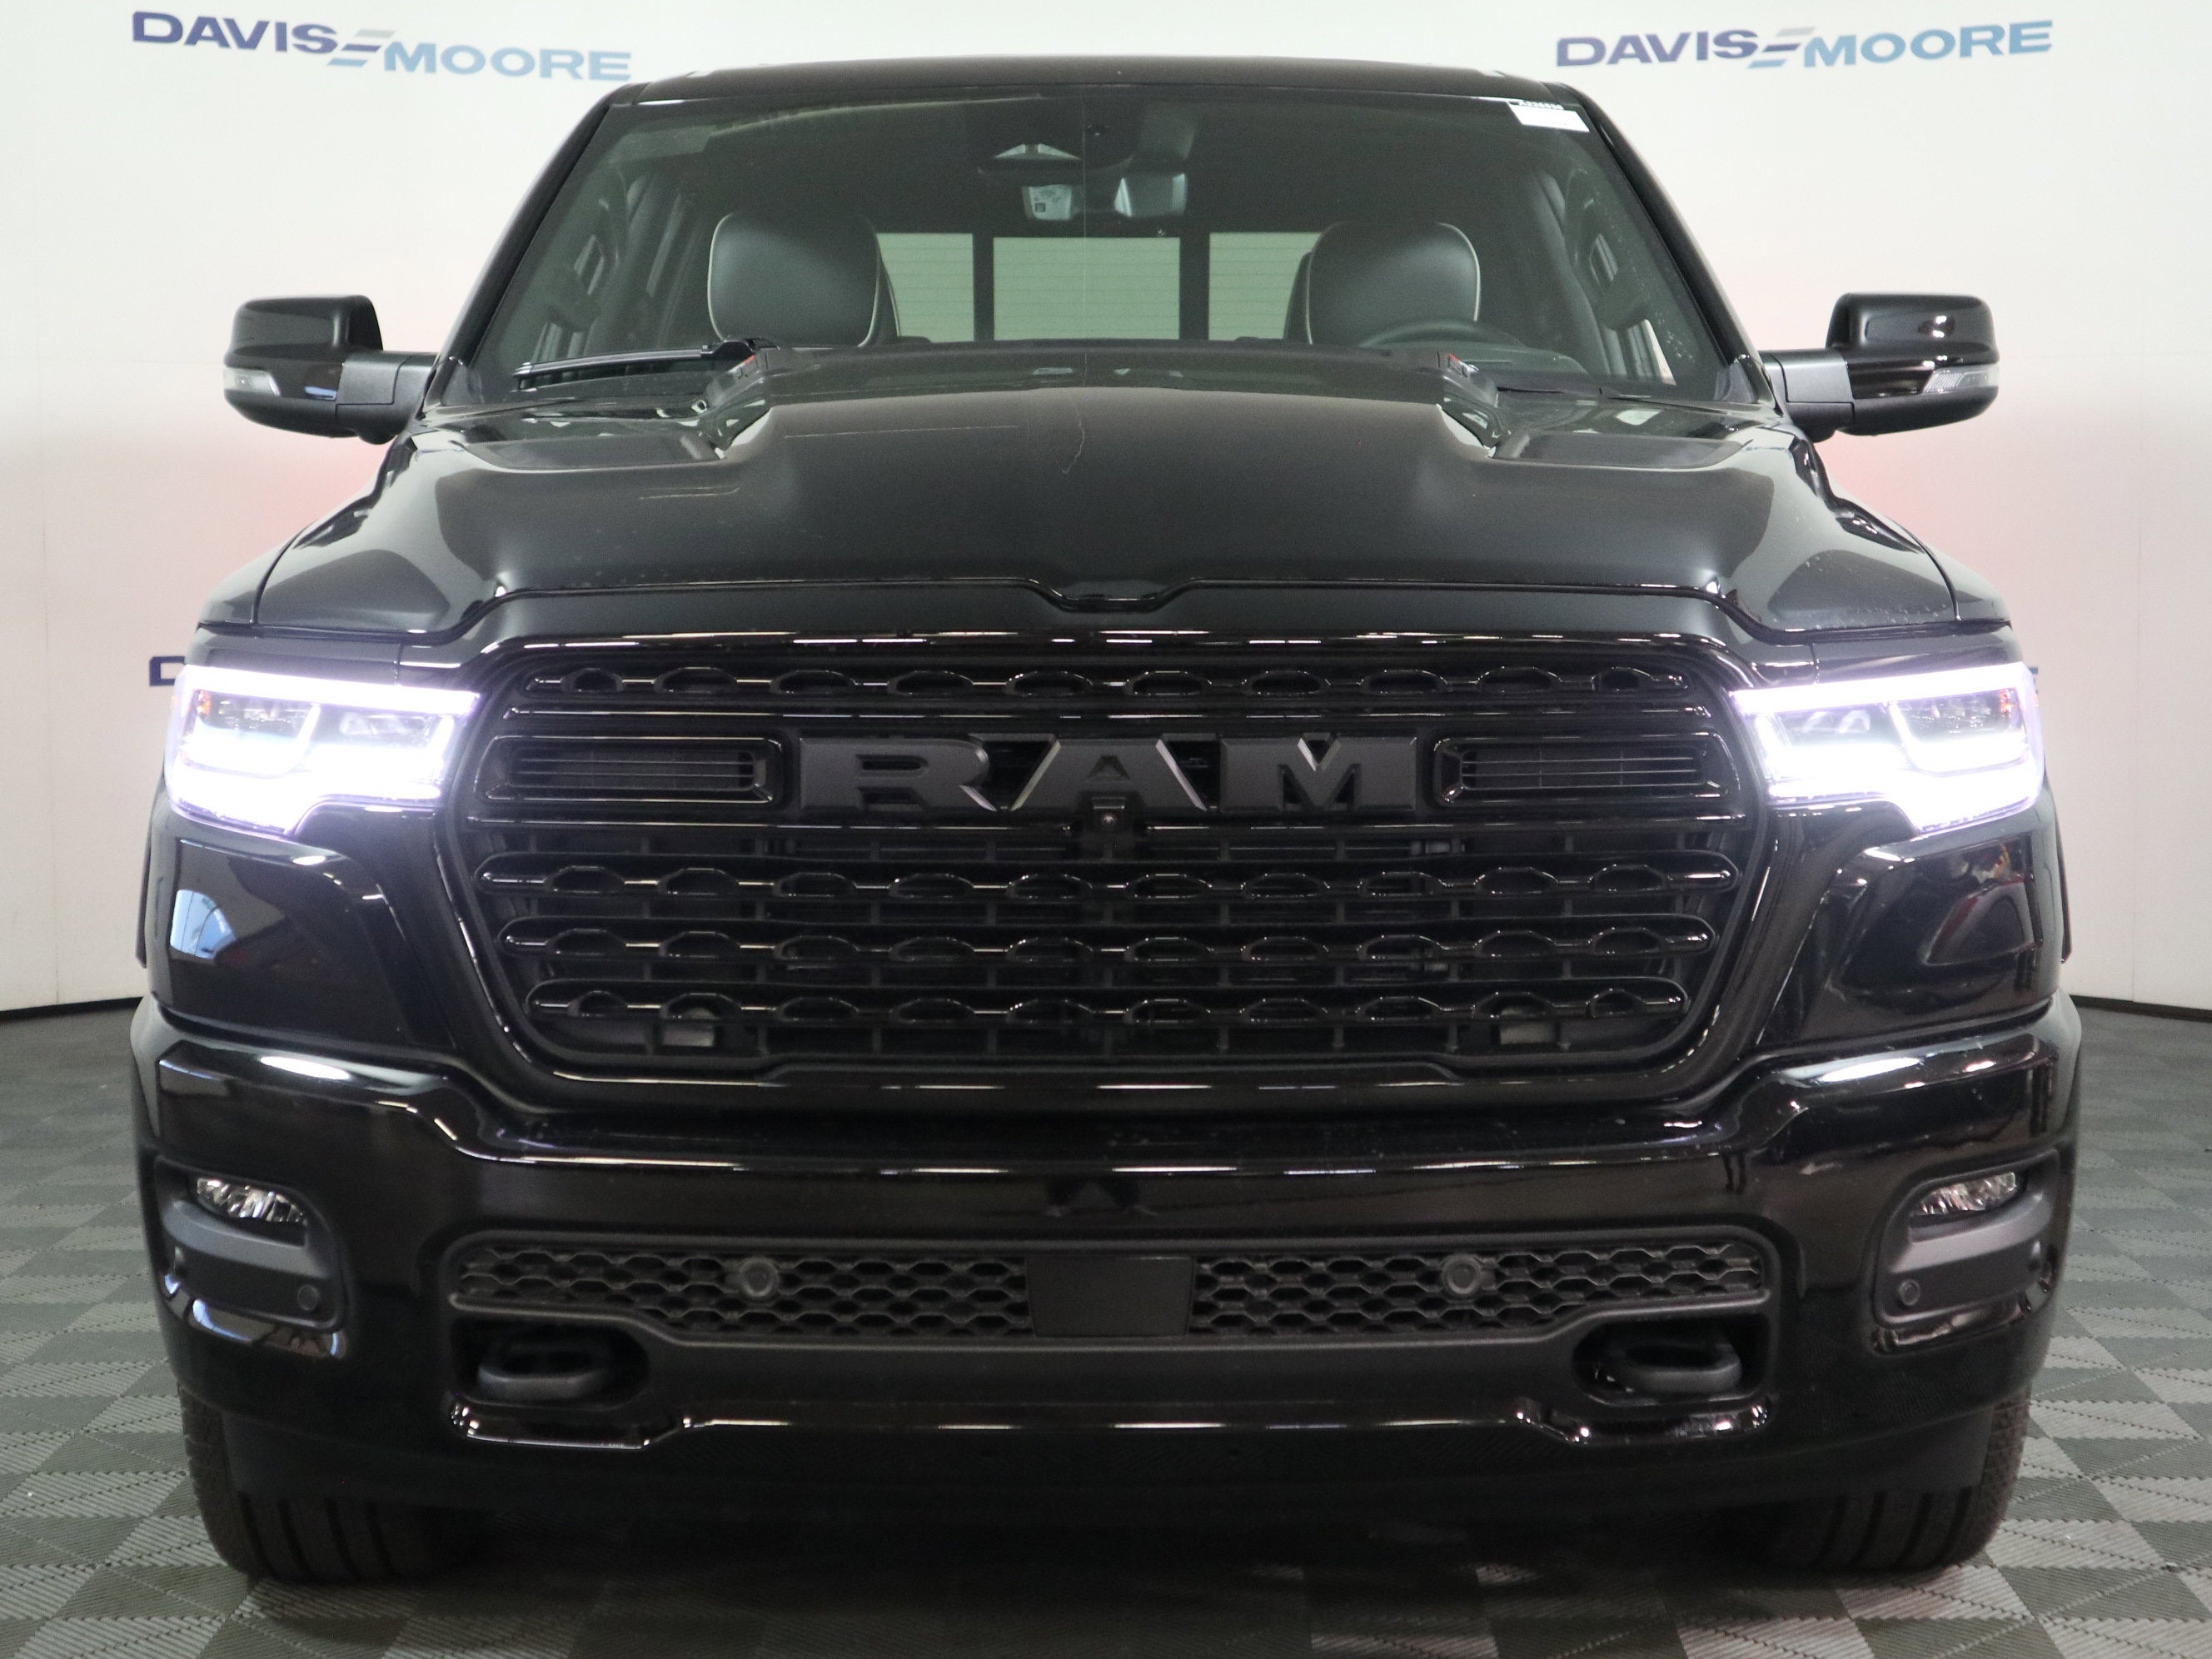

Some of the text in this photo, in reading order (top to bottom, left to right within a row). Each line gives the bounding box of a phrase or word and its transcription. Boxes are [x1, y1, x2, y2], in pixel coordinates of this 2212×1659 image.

[131, 11, 631, 82] DAVIS MOORE
[1556, 20, 2054, 68] DAVIS MOORE
[800, 736, 1417, 812] RAM
